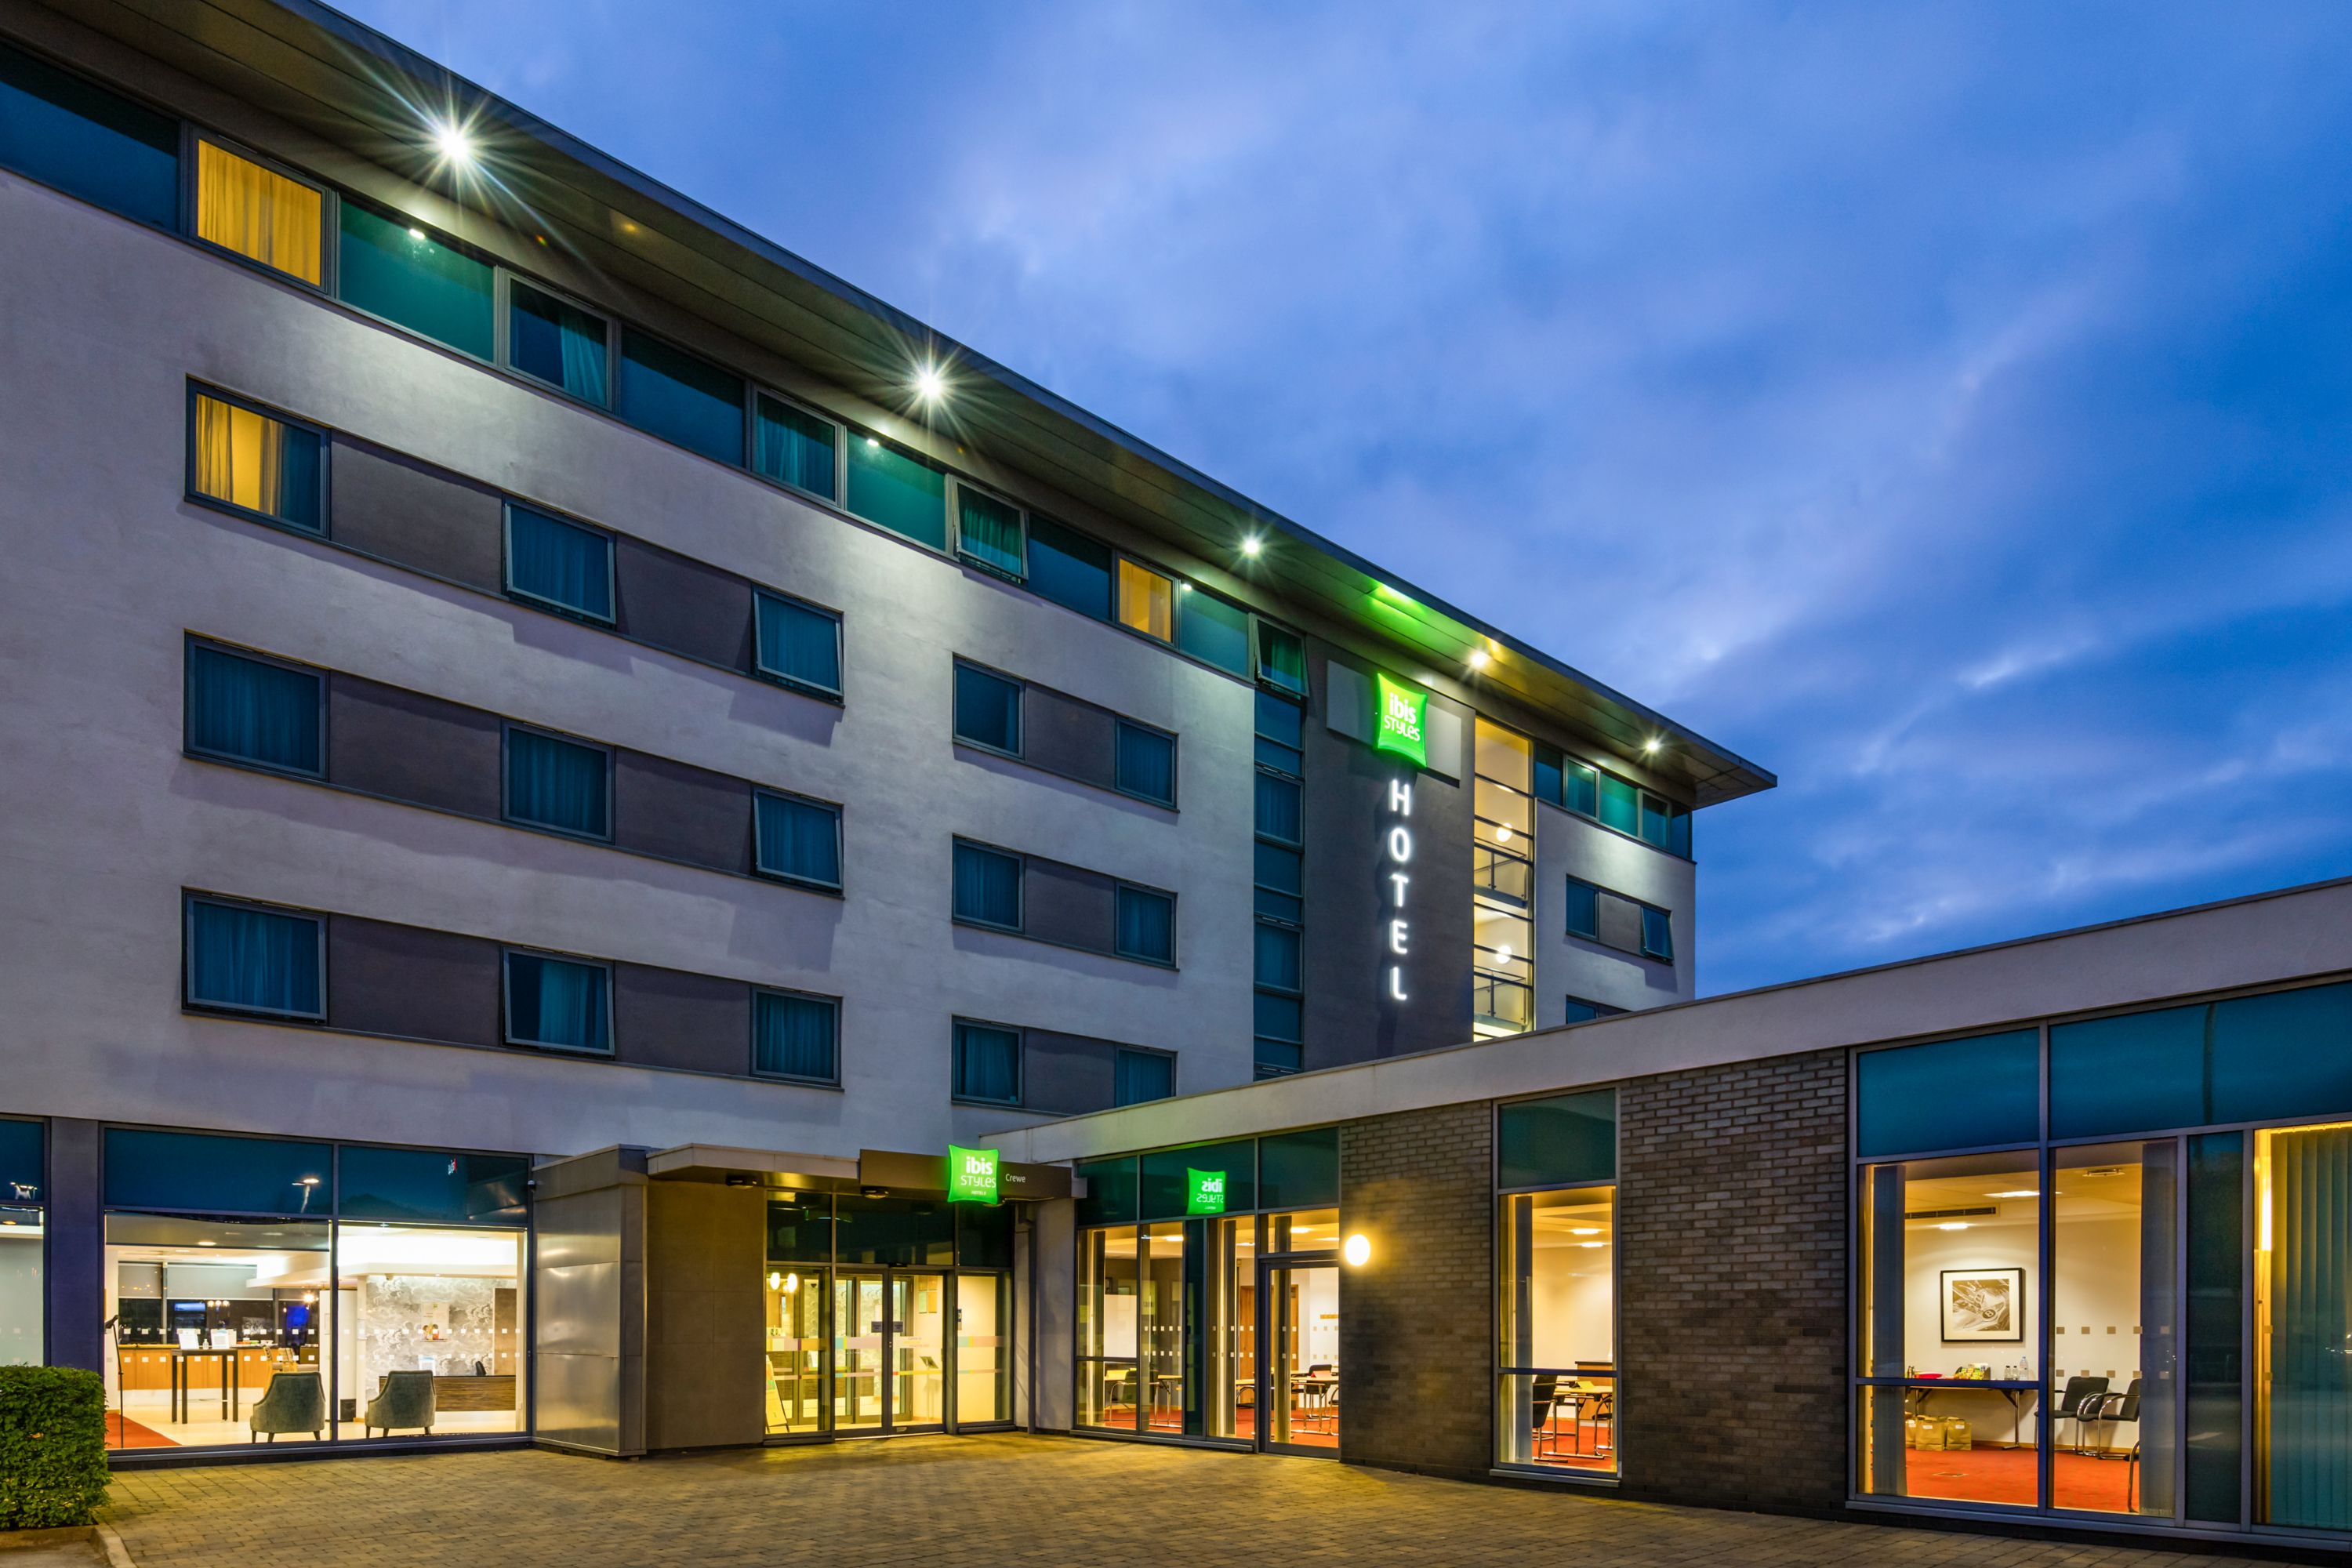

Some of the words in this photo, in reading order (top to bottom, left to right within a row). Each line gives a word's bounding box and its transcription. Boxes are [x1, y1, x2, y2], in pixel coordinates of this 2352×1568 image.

[1388, 692, 1417, 724] ibis
[1388, 779, 1412, 1001] HOTEL
[966, 1156, 993, 1174] ibis
[1005, 1174, 1026, 1183] Crewe
